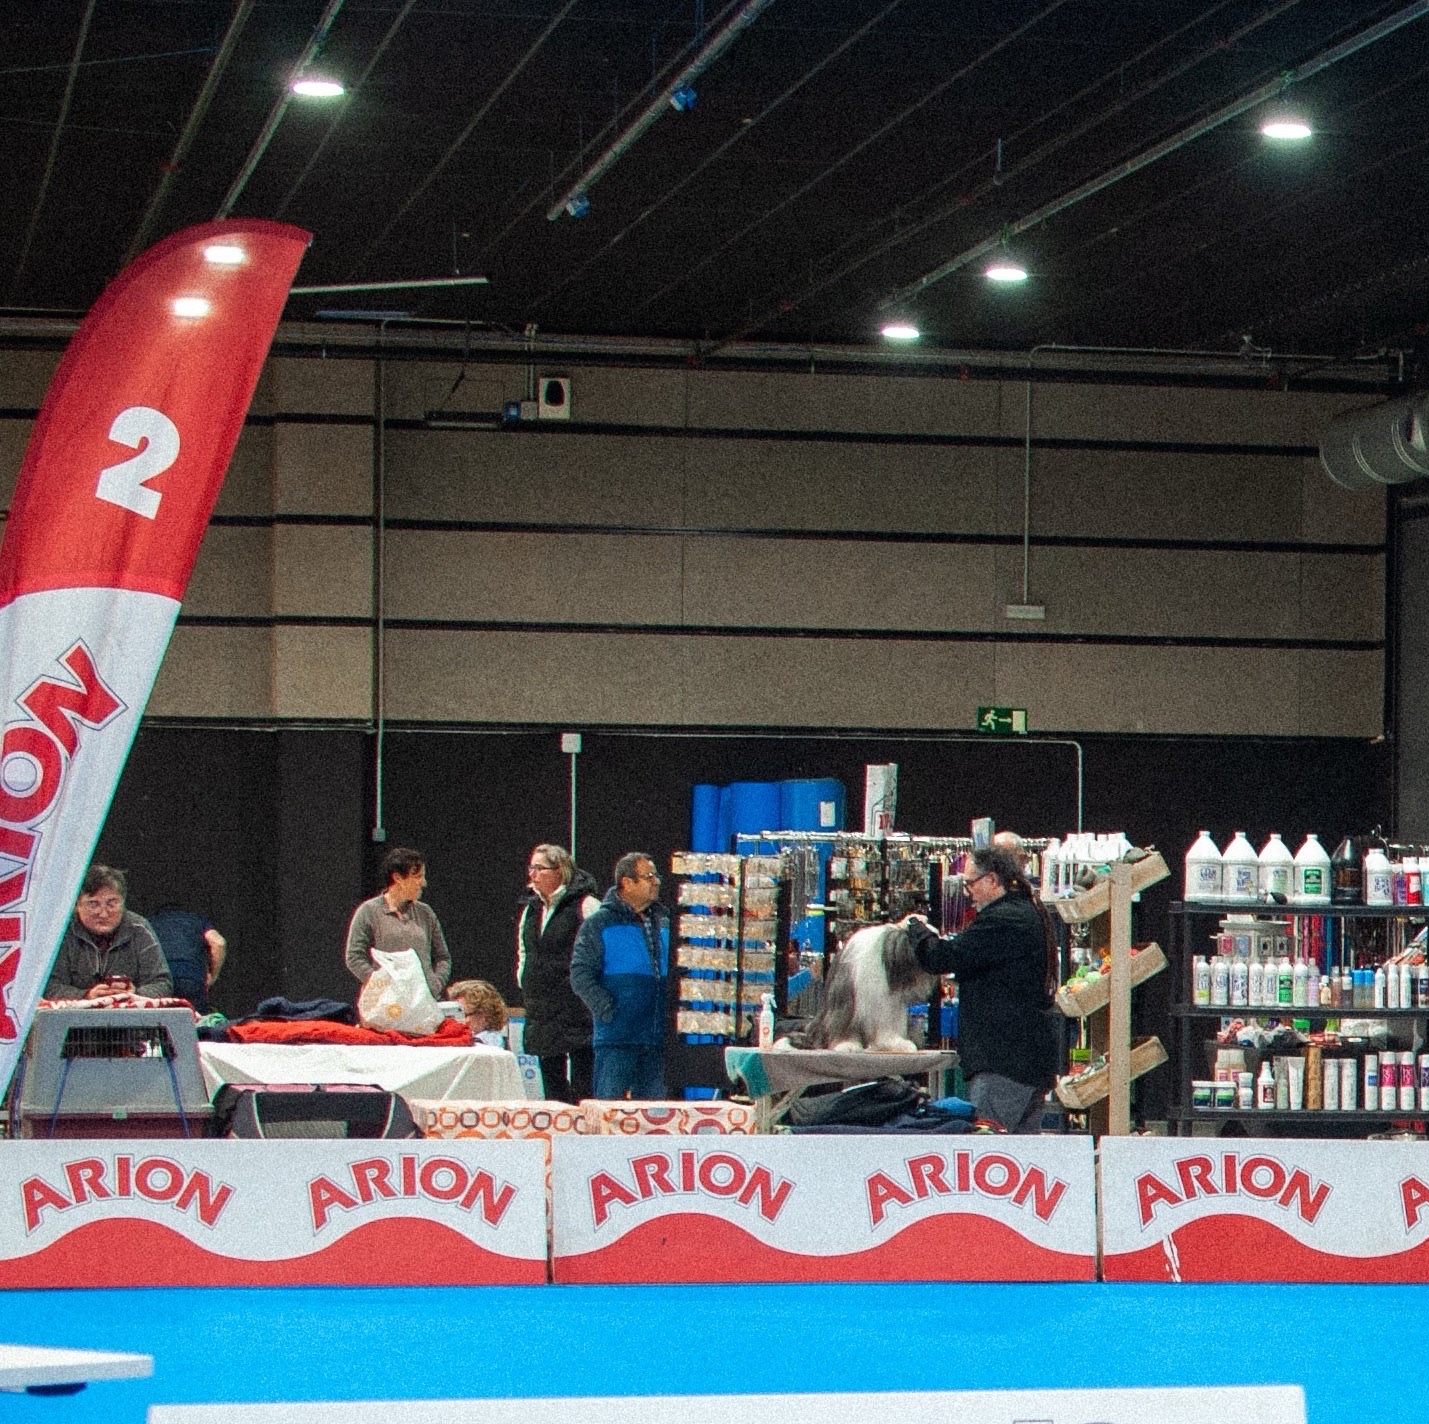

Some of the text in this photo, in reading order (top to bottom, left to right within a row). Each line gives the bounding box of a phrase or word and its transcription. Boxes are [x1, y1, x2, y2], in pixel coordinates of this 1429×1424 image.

[95, 406, 182, 520] 2
[21, 1154, 233, 1231] ARION
[308, 1154, 516, 1230] ARION
[589, 1150, 793, 1226] ARION
[865, 1150, 1067, 1226] ARION
[1135, 1152, 1331, 1226] ARION
